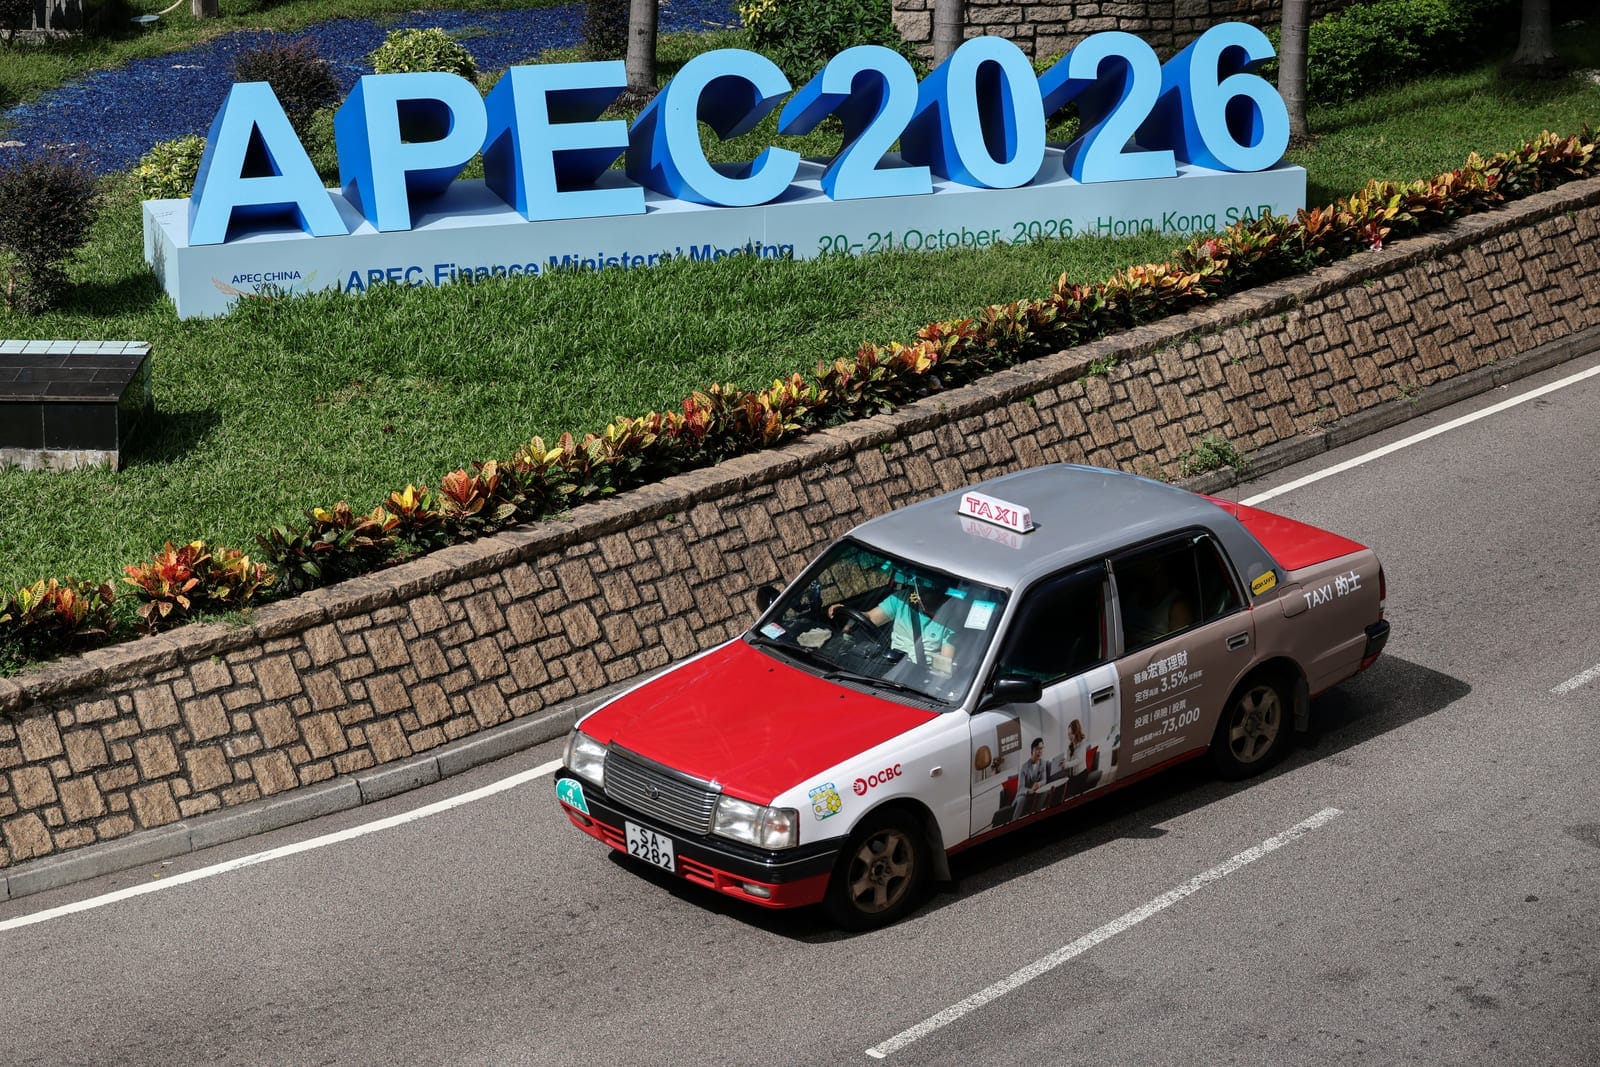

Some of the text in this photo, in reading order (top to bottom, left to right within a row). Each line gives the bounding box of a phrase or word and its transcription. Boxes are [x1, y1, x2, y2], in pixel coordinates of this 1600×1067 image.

[1013, 218, 1073, 243] 2026
[1097, 215, 1153, 237] Hong
[1162, 210, 1216, 233] Kong
[231, 271, 302, 284] APEC CHINA
[345, 265, 423, 291] APEC
[966, 497, 1018, 526] TAXI
[1303, 570, 1362, 609] TAXI 的士
[1160, 669, 1189, 693] 3.5%
[867, 763, 903, 788] OCBC
[639, 828, 660, 850] SA
[630, 839, 672, 870] 2282
